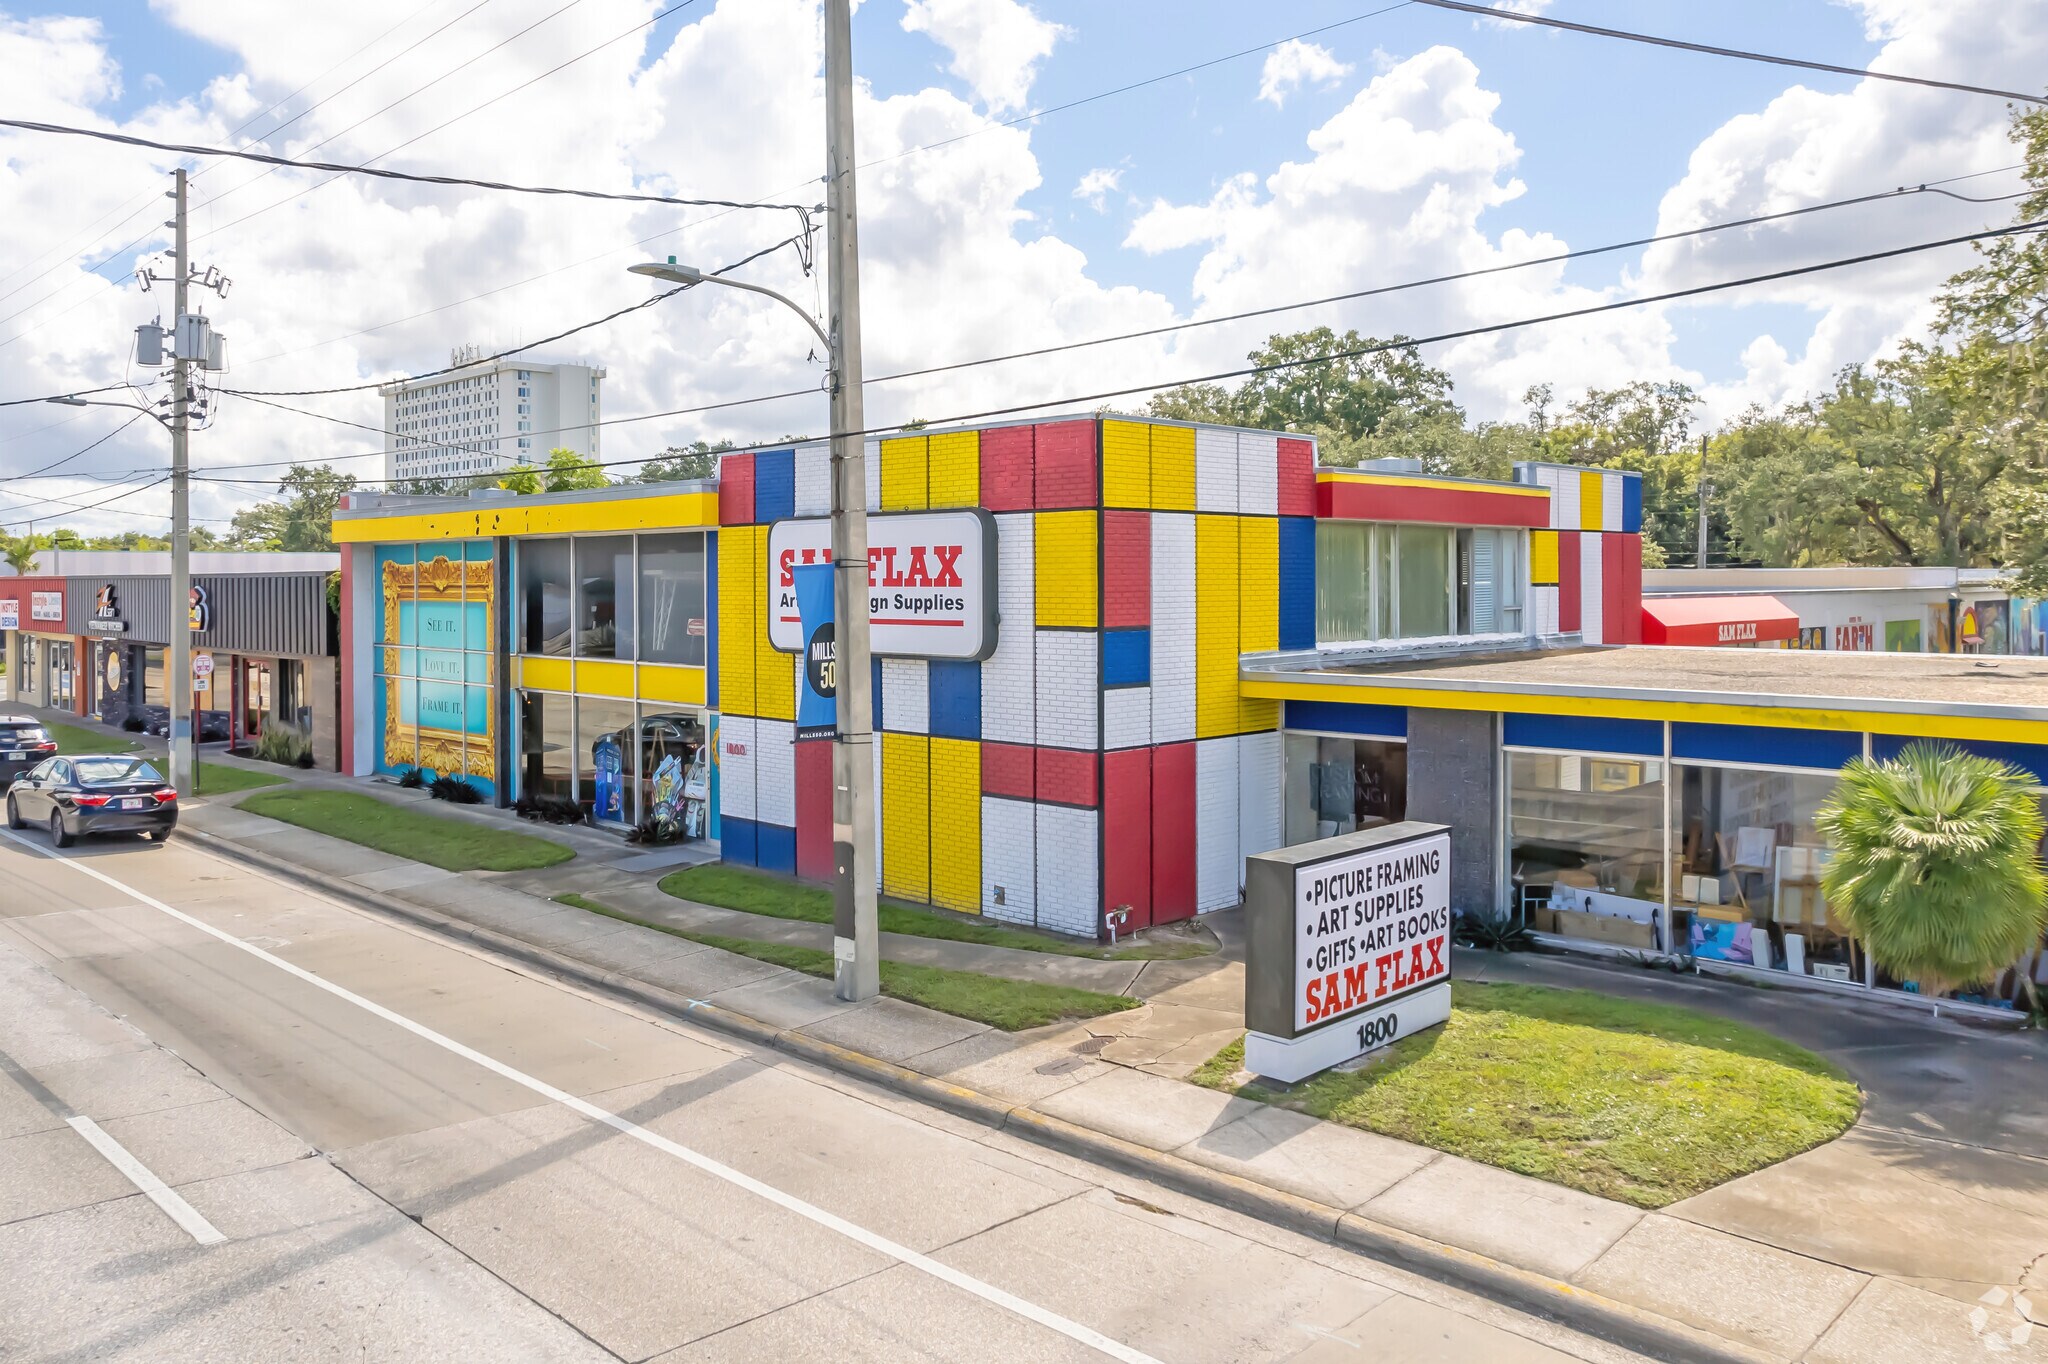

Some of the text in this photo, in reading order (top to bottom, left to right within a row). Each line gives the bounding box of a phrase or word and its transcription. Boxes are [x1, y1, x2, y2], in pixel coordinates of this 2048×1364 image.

[780, 592, 798, 608] Ar
[894, 593, 965, 614] Supplies
[427, 617, 442, 632] SEE
[1718, 623, 1757, 642] SAM FLAX
[812, 641, 836, 661] MILLS
[425, 658, 446, 673] LOVE
[820, 661, 837, 689] 50
[422, 696, 449, 713] FRAME
[1314, 849, 1440, 906] PICTURE FRAMING
[1316, 884, 1424, 938] ART SUPPLIES
[1316, 906, 1447, 972] GIFTS ART BOOKS
[1306, 934, 1445, 1024] SAM FLAX
[1356, 1013, 1398, 1050] 1800
